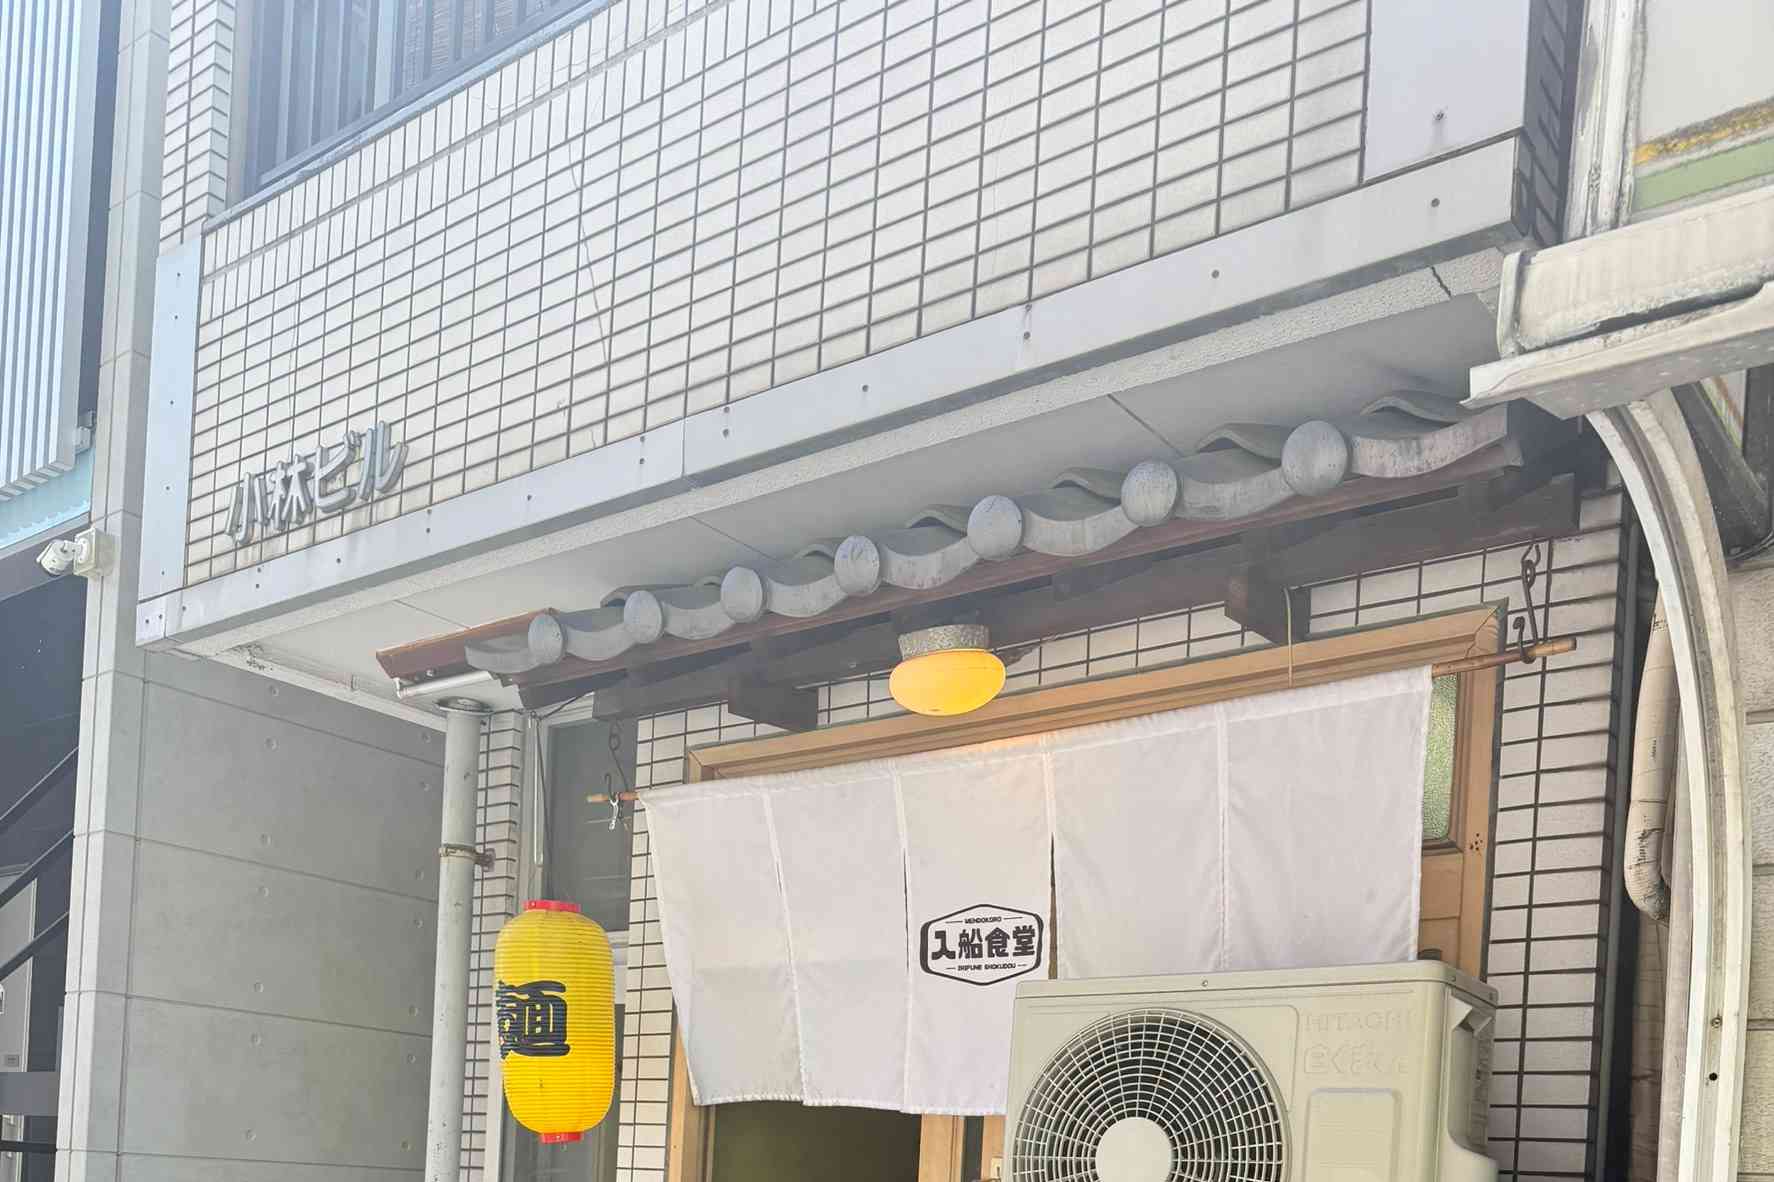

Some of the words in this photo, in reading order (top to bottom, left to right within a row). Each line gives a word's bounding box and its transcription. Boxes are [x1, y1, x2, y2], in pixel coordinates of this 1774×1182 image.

[224, 420, 409, 545] 小林ビル
[931, 925, 1036, 960] 入船食堂
